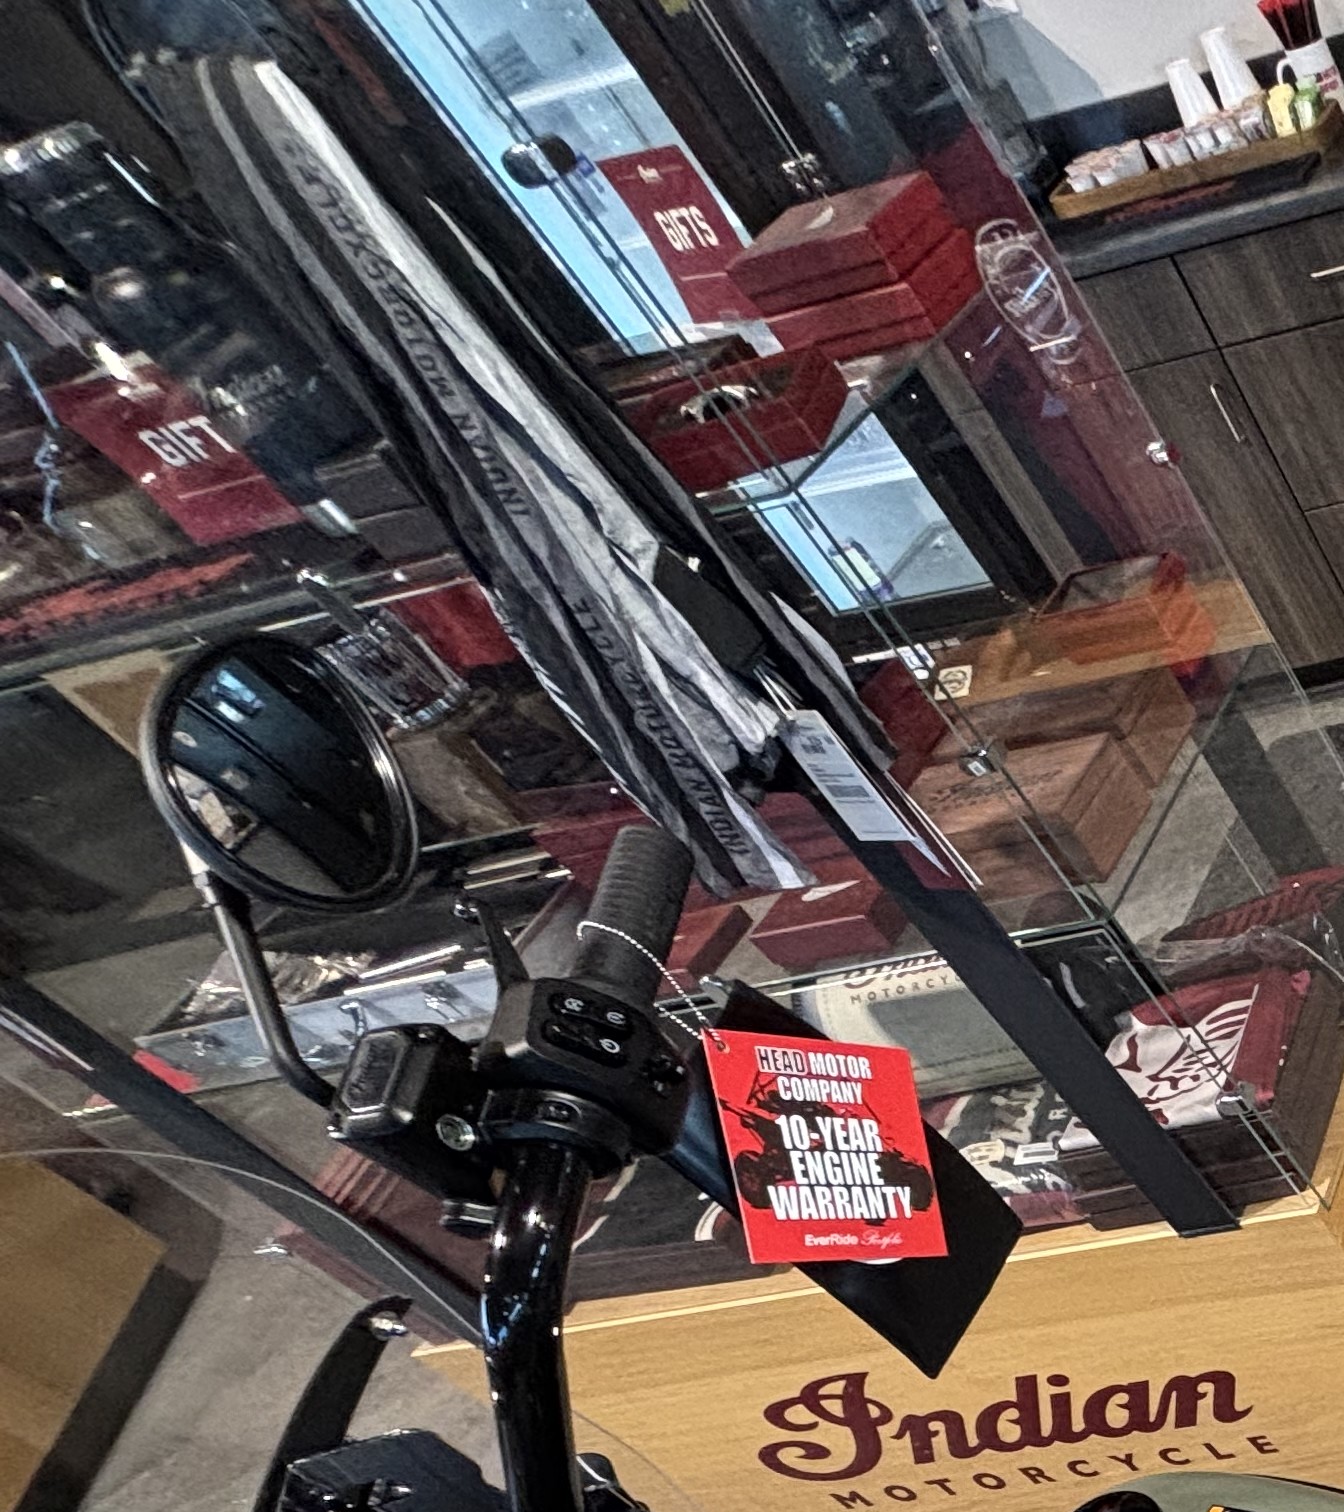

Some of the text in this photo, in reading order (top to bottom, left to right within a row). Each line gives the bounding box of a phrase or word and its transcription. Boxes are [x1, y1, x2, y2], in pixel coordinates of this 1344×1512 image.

[653, 205, 720, 253] GIFTS
[688, 777, 751, 855] INDIAN
[851, 973, 960, 1005] MOTORCYC
[757, 1047, 872, 1080] HEAD MOTOR
[776, 1076, 863, 1105] COMPANY
[775, 1114, 883, 1152] 10-YEAR
[789, 1150, 885, 1186] ENGINE
[767, 1185, 913, 1220] WARRANTY
[758, 1370, 1254, 1482] Indian
[830, 1434, 1281, 1510] MOTORCYCLE
